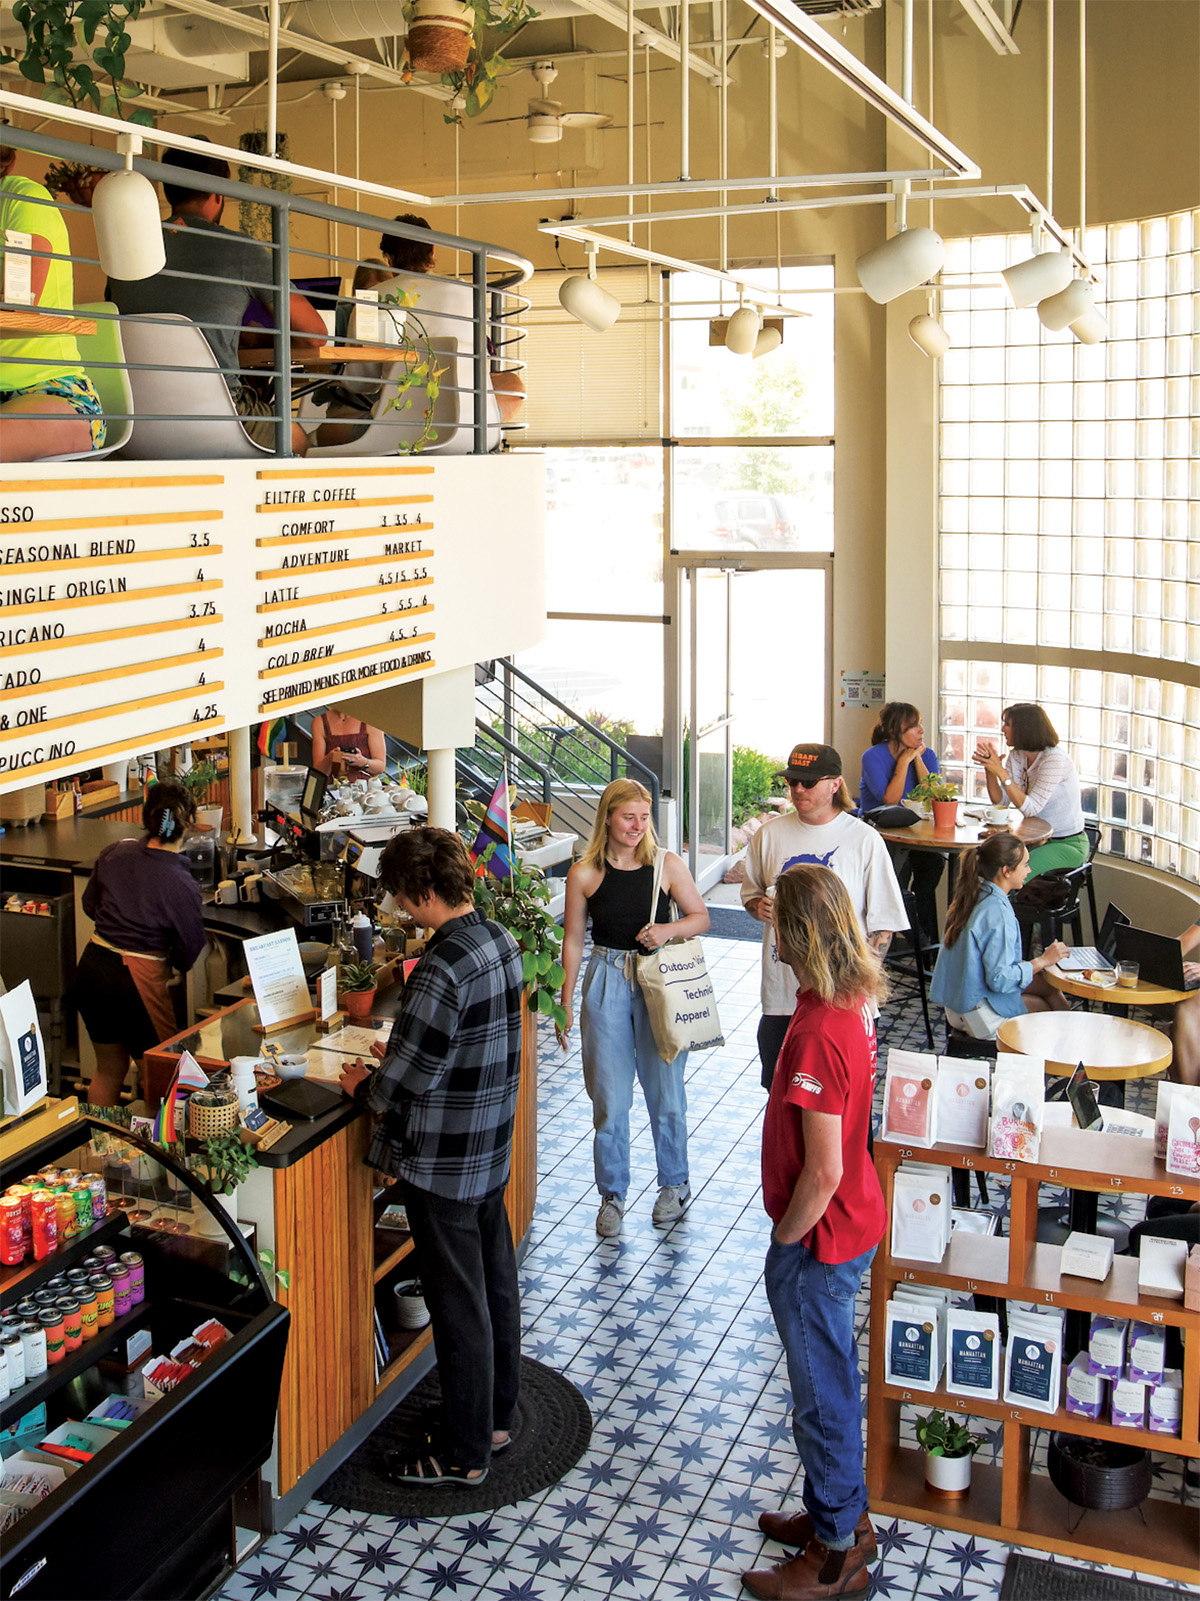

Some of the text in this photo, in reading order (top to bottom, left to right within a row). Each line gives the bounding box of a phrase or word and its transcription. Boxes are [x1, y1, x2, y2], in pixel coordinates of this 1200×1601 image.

[313, 488, 357, 502] COFFEE
[0, 506, 34, 523] SSO
[282, 520, 335, 536] COMFORT
[416, 513, 422, 524] 4
[0, 533, 210, 564] EASONAL BLEND 3.5
[282, 540, 422, 569] ADVENTURE MARKET
[67, 577, 127, 598] ORIGIN
[196, 568, 204, 582] 4
[264, 587, 300, 604] LATTE
[414, 567, 427, 580] 5.5
[0, 601, 216, 646] RICANO 3.75
[265, 618, 307, 638] MOCHA
[422, 595, 428, 606] 6
[268, 651, 300, 670] COLD
[303, 644, 335, 663] BREW
[412, 626, 418, 637] 5
[0, 638, 206, 689] ADO 4
[262, 650, 431, 705] SEE PRINTED MENUS FOR MORE FOOD & DRINKS
[0, 672, 206, 731] & ONE 4
[192, 704, 218, 722] 4.25
[658, 960, 695, 974] Outdoor
[674, 1006, 710, 1024] Apparel
[898, 1148, 913, 1158] 20
[961, 1157, 974, 1167] 16
[1005, 1162, 1017, 1171] 23
[1049, 1169, 1058, 1178] 21
[1110, 1178, 1122, 1187] 17
[1169, 1185, 1184, 1195] 23
[903, 1272, 915, 1280] 16
[967, 1280, 978, 1291] 16
[1045, 1293, 1054, 1303] 21
[898, 1341, 925, 1351] MANHATTAN
[959, 1350, 986, 1359] MANHATTAN
[1017, 1358, 1045, 1370] MANHATTAN
[902, 1391, 912, 1400] 12
[956, 1400, 967, 1408] 12
[1010, 1410, 1023, 1420] 12
